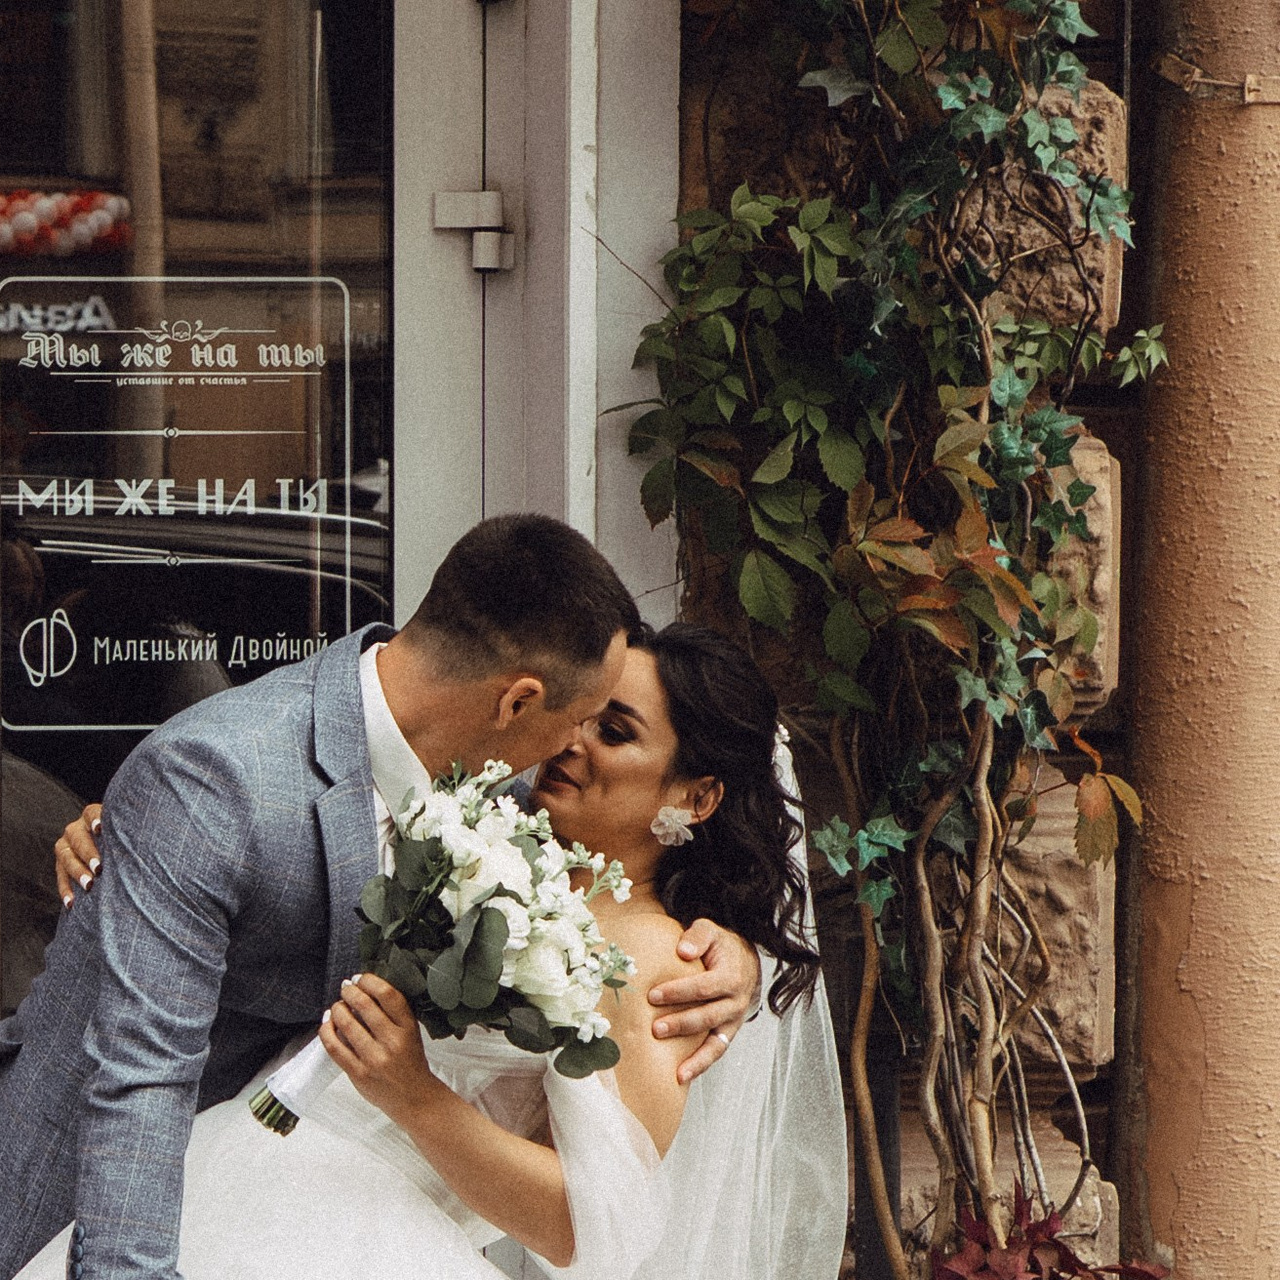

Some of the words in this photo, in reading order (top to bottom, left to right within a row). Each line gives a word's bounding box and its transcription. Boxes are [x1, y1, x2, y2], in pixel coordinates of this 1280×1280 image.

[18, 331, 102, 368] Мы
[120, 342, 172, 368] же
[190, 342, 239, 368] на
[257, 342, 327, 368] ты
[178, 376, 196, 386] от
[200, 376, 248, 386] счастья
[18, 478, 94, 516] МЫ
[114, 478, 176, 516] ЖЕ
[197, 478, 256, 516] НА
[275, 478, 328, 516] ТЫ
